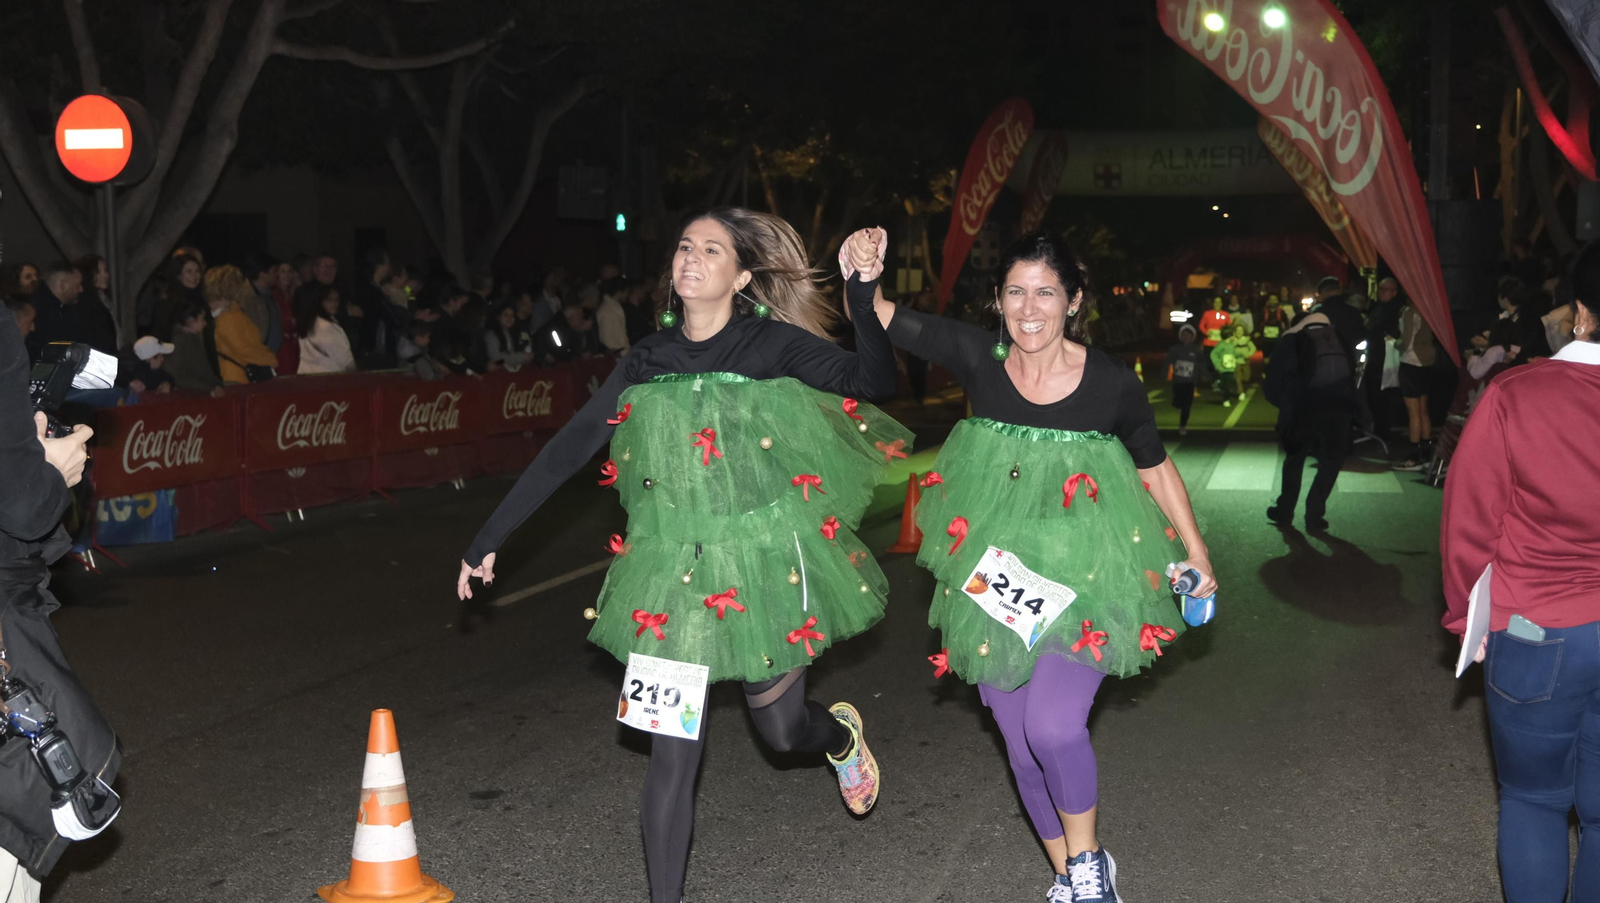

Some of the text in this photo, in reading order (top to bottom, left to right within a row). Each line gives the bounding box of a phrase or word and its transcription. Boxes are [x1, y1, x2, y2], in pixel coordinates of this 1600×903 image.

[959, 106, 1027, 235] Coca-Cola
[400, 390, 464, 436] Coca-Cola
[502, 380, 555, 420] Coca-Cola
[122, 413, 207, 475] Coca-Cola
[277, 400, 351, 451] Coca-Cola
[991, 572, 1045, 616] 214
[998, 600, 1022, 616] CARMEN
[643, 706, 660, 716] IRENE
